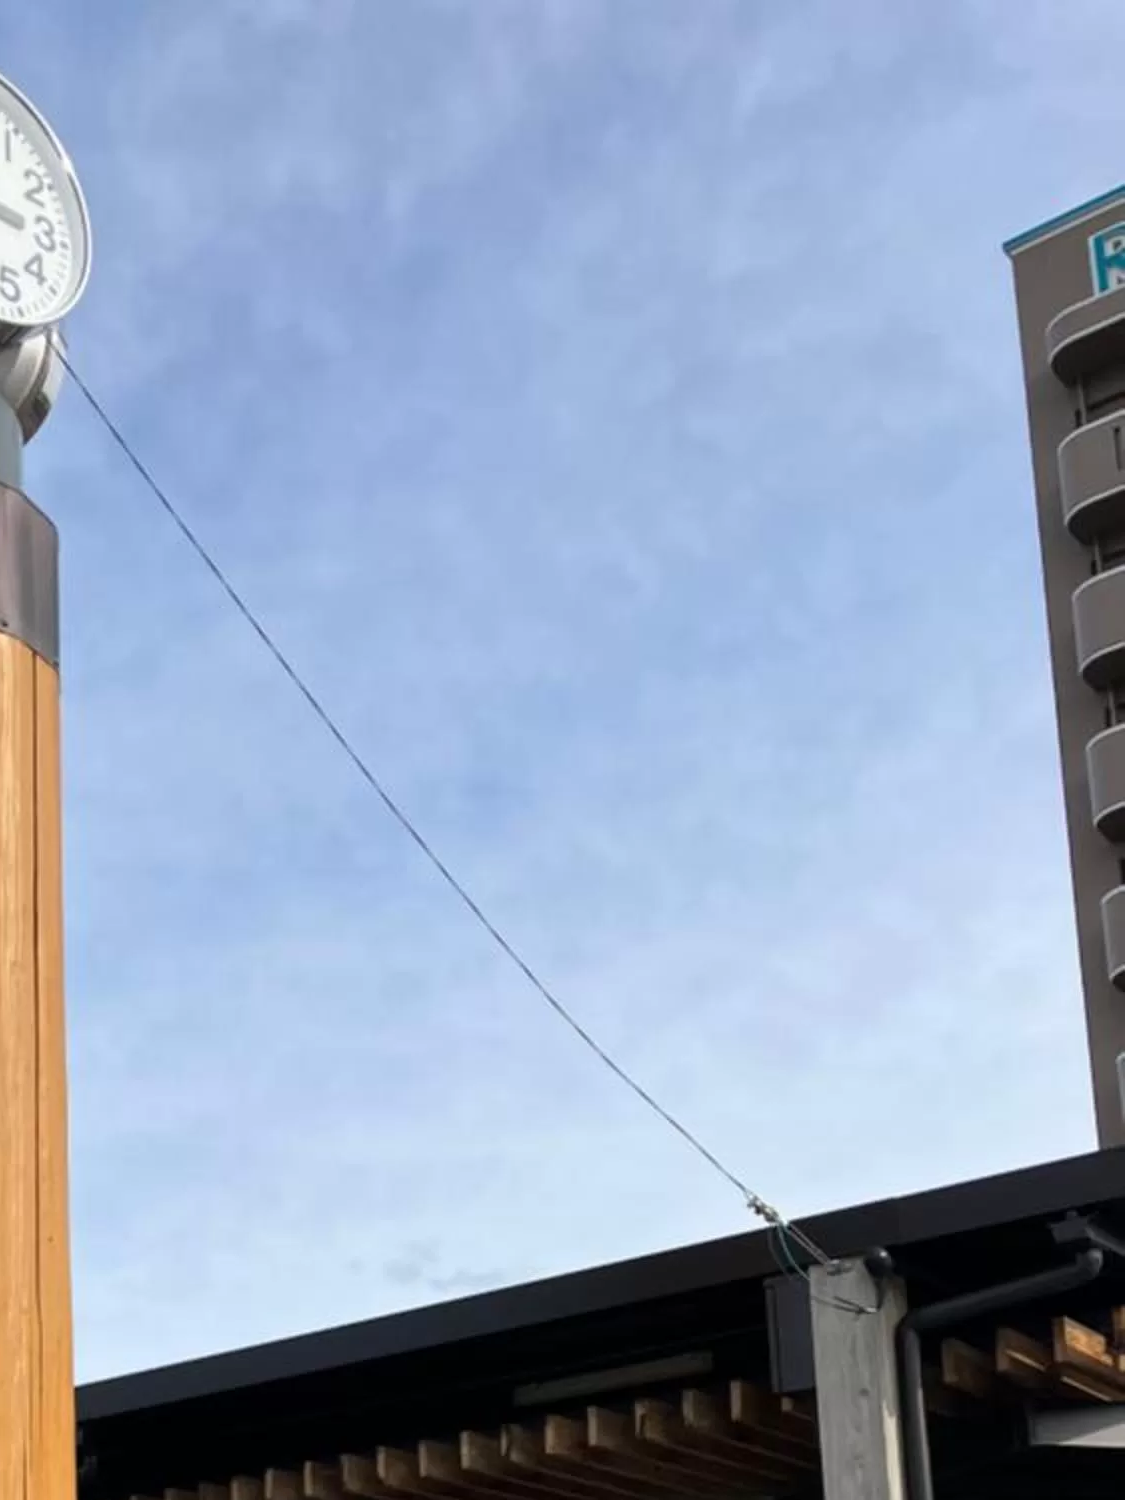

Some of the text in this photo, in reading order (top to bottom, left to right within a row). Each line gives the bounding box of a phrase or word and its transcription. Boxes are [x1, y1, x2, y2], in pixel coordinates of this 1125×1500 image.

[23, 170, 45, 208] 2
[33, 216, 56, 252] 3
[23, 253, 47, 287] 4
